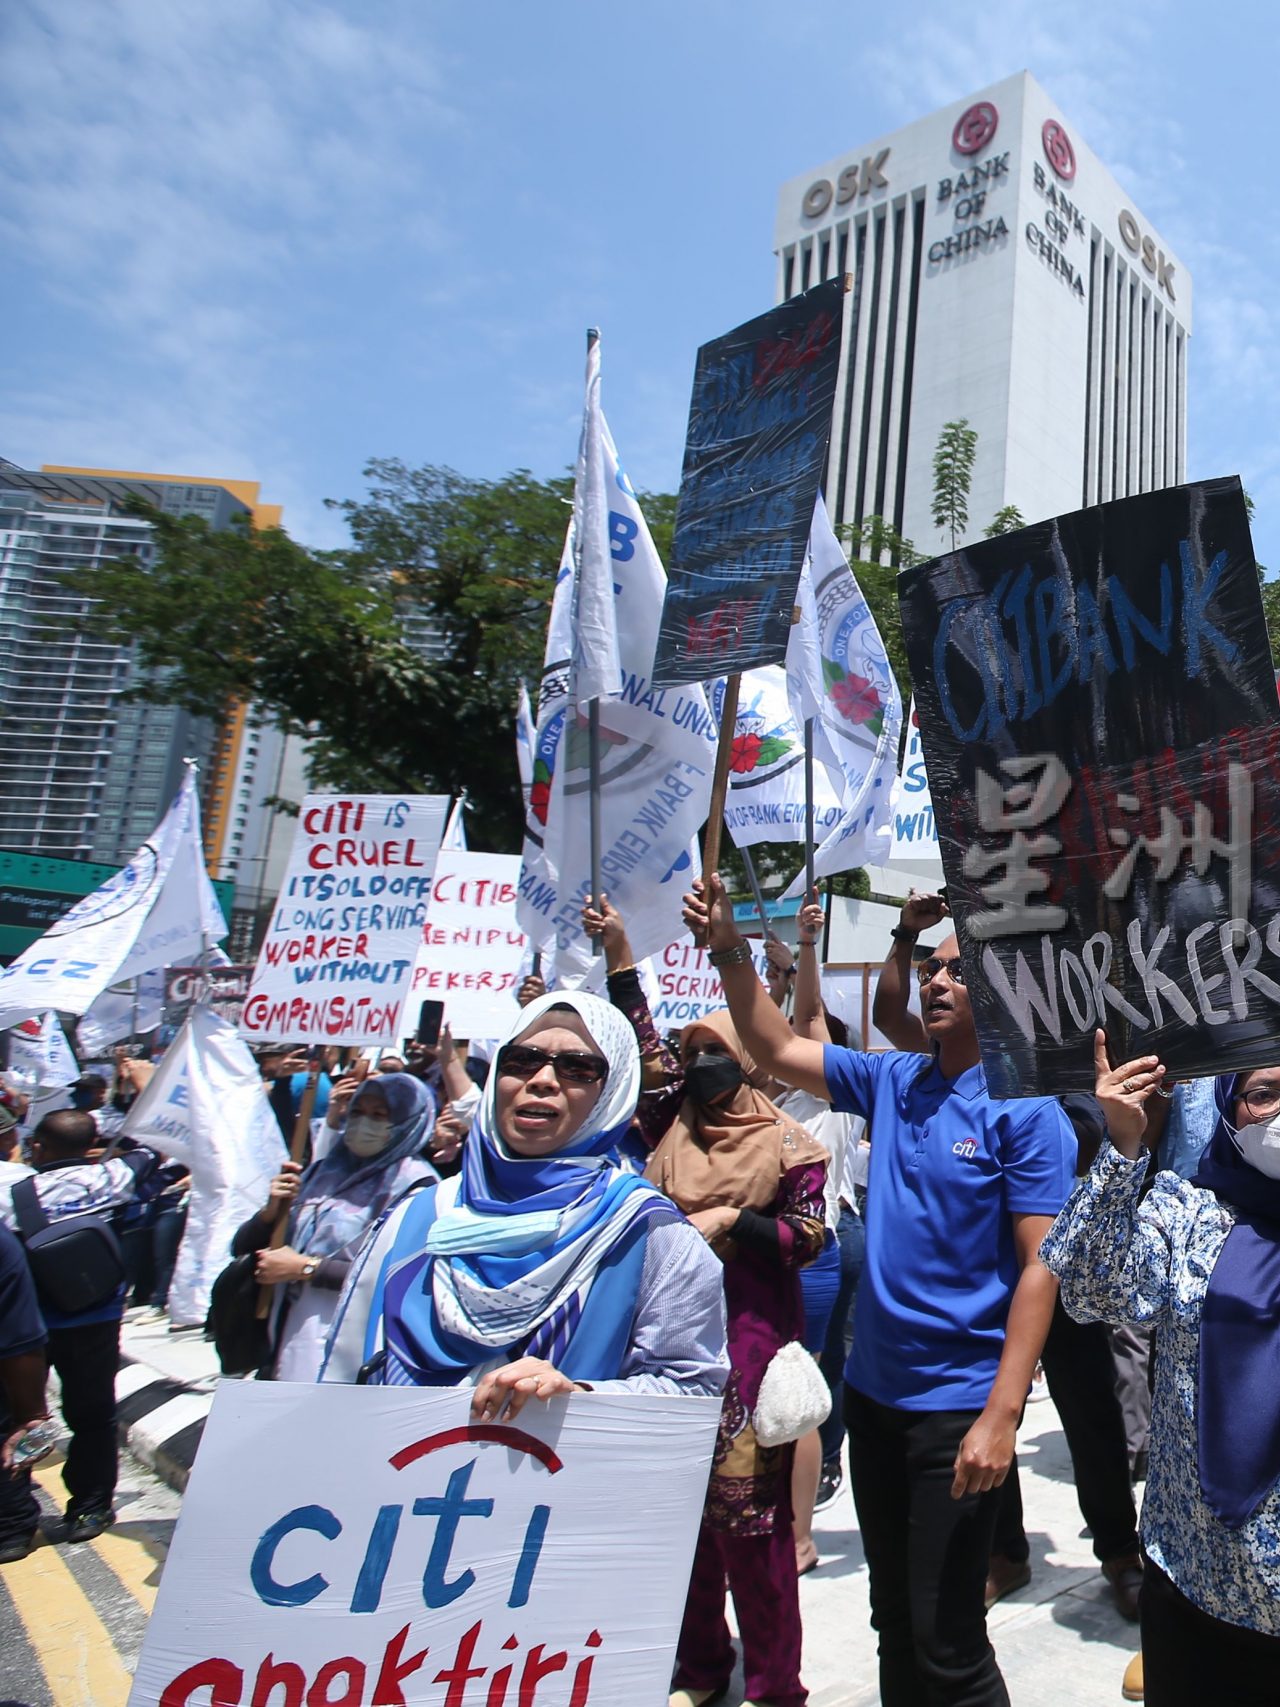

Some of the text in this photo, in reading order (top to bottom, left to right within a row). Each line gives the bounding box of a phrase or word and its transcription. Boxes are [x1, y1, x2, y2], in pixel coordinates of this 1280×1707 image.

[802, 147, 891, 218] OSK
[937, 152, 1010, 201] BANK
[955, 191, 987, 220] OF
[1033, 161, 1086, 236] BANK
[928, 215, 1010, 263] CHINA
[1044, 211, 1069, 244] OF
[1025, 223, 1086, 300] CHINA
[1118, 209, 1177, 302] OSK
[304, 801, 410, 835] CITI IS
[750, 803, 781, 825] BANK
[308, 839, 424, 870] CRUEL
[434, 874, 518, 907] CITIB
[265, 934, 369, 967] WORKER
[294, 960, 411, 985] WITHOUT
[243, 994, 400, 1038] COMPENSATION
[953, 1140, 977, 1159] citi
[249, 1458, 551, 1613] citi
